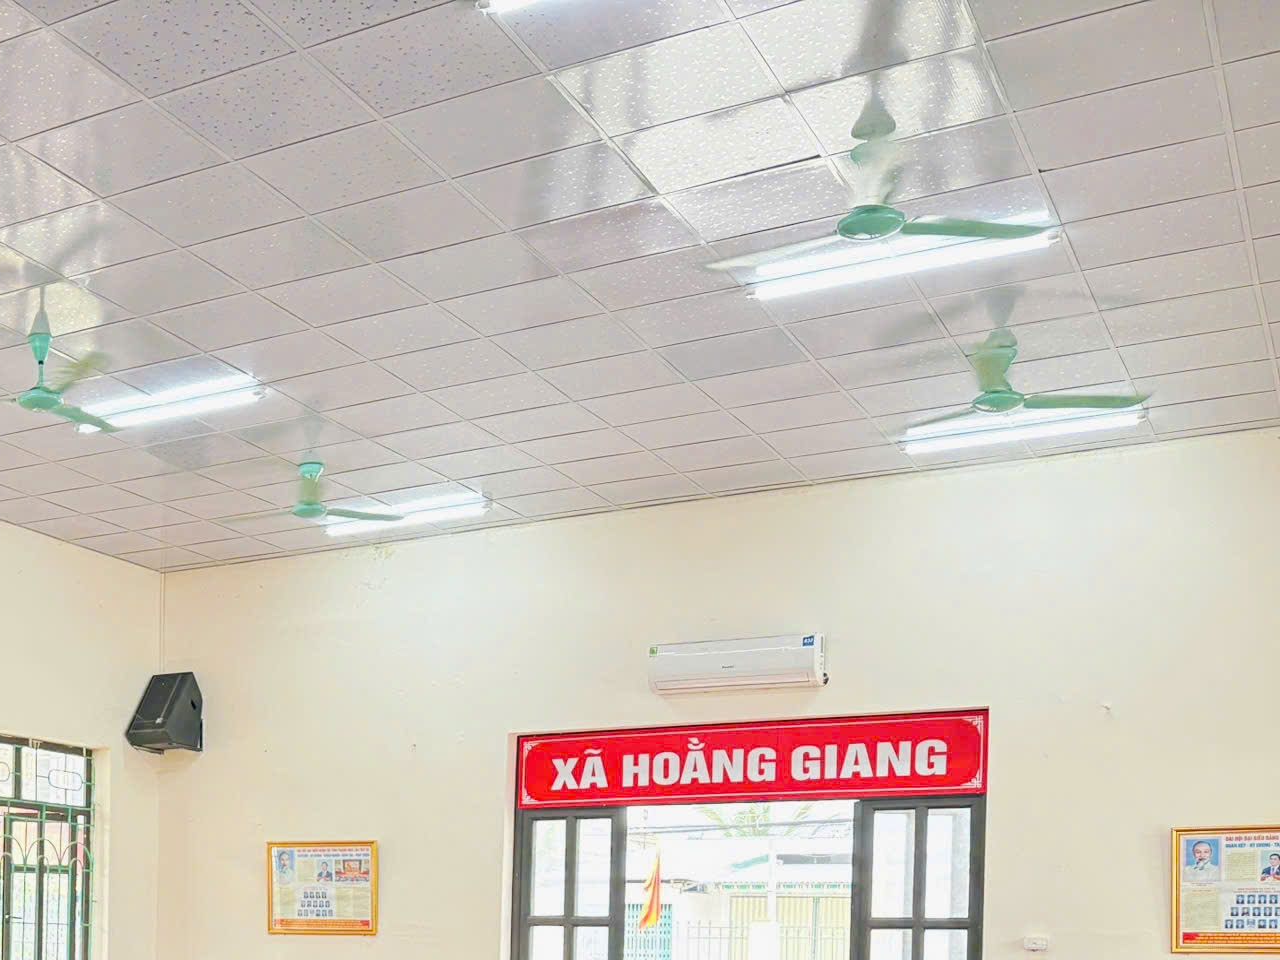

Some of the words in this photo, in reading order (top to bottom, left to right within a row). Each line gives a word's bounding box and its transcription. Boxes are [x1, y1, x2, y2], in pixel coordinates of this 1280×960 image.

[551, 748, 608, 791] XÃ
[622, 737, 777, 788] HOẰNG
[791, 739, 948, 782] GIANG
